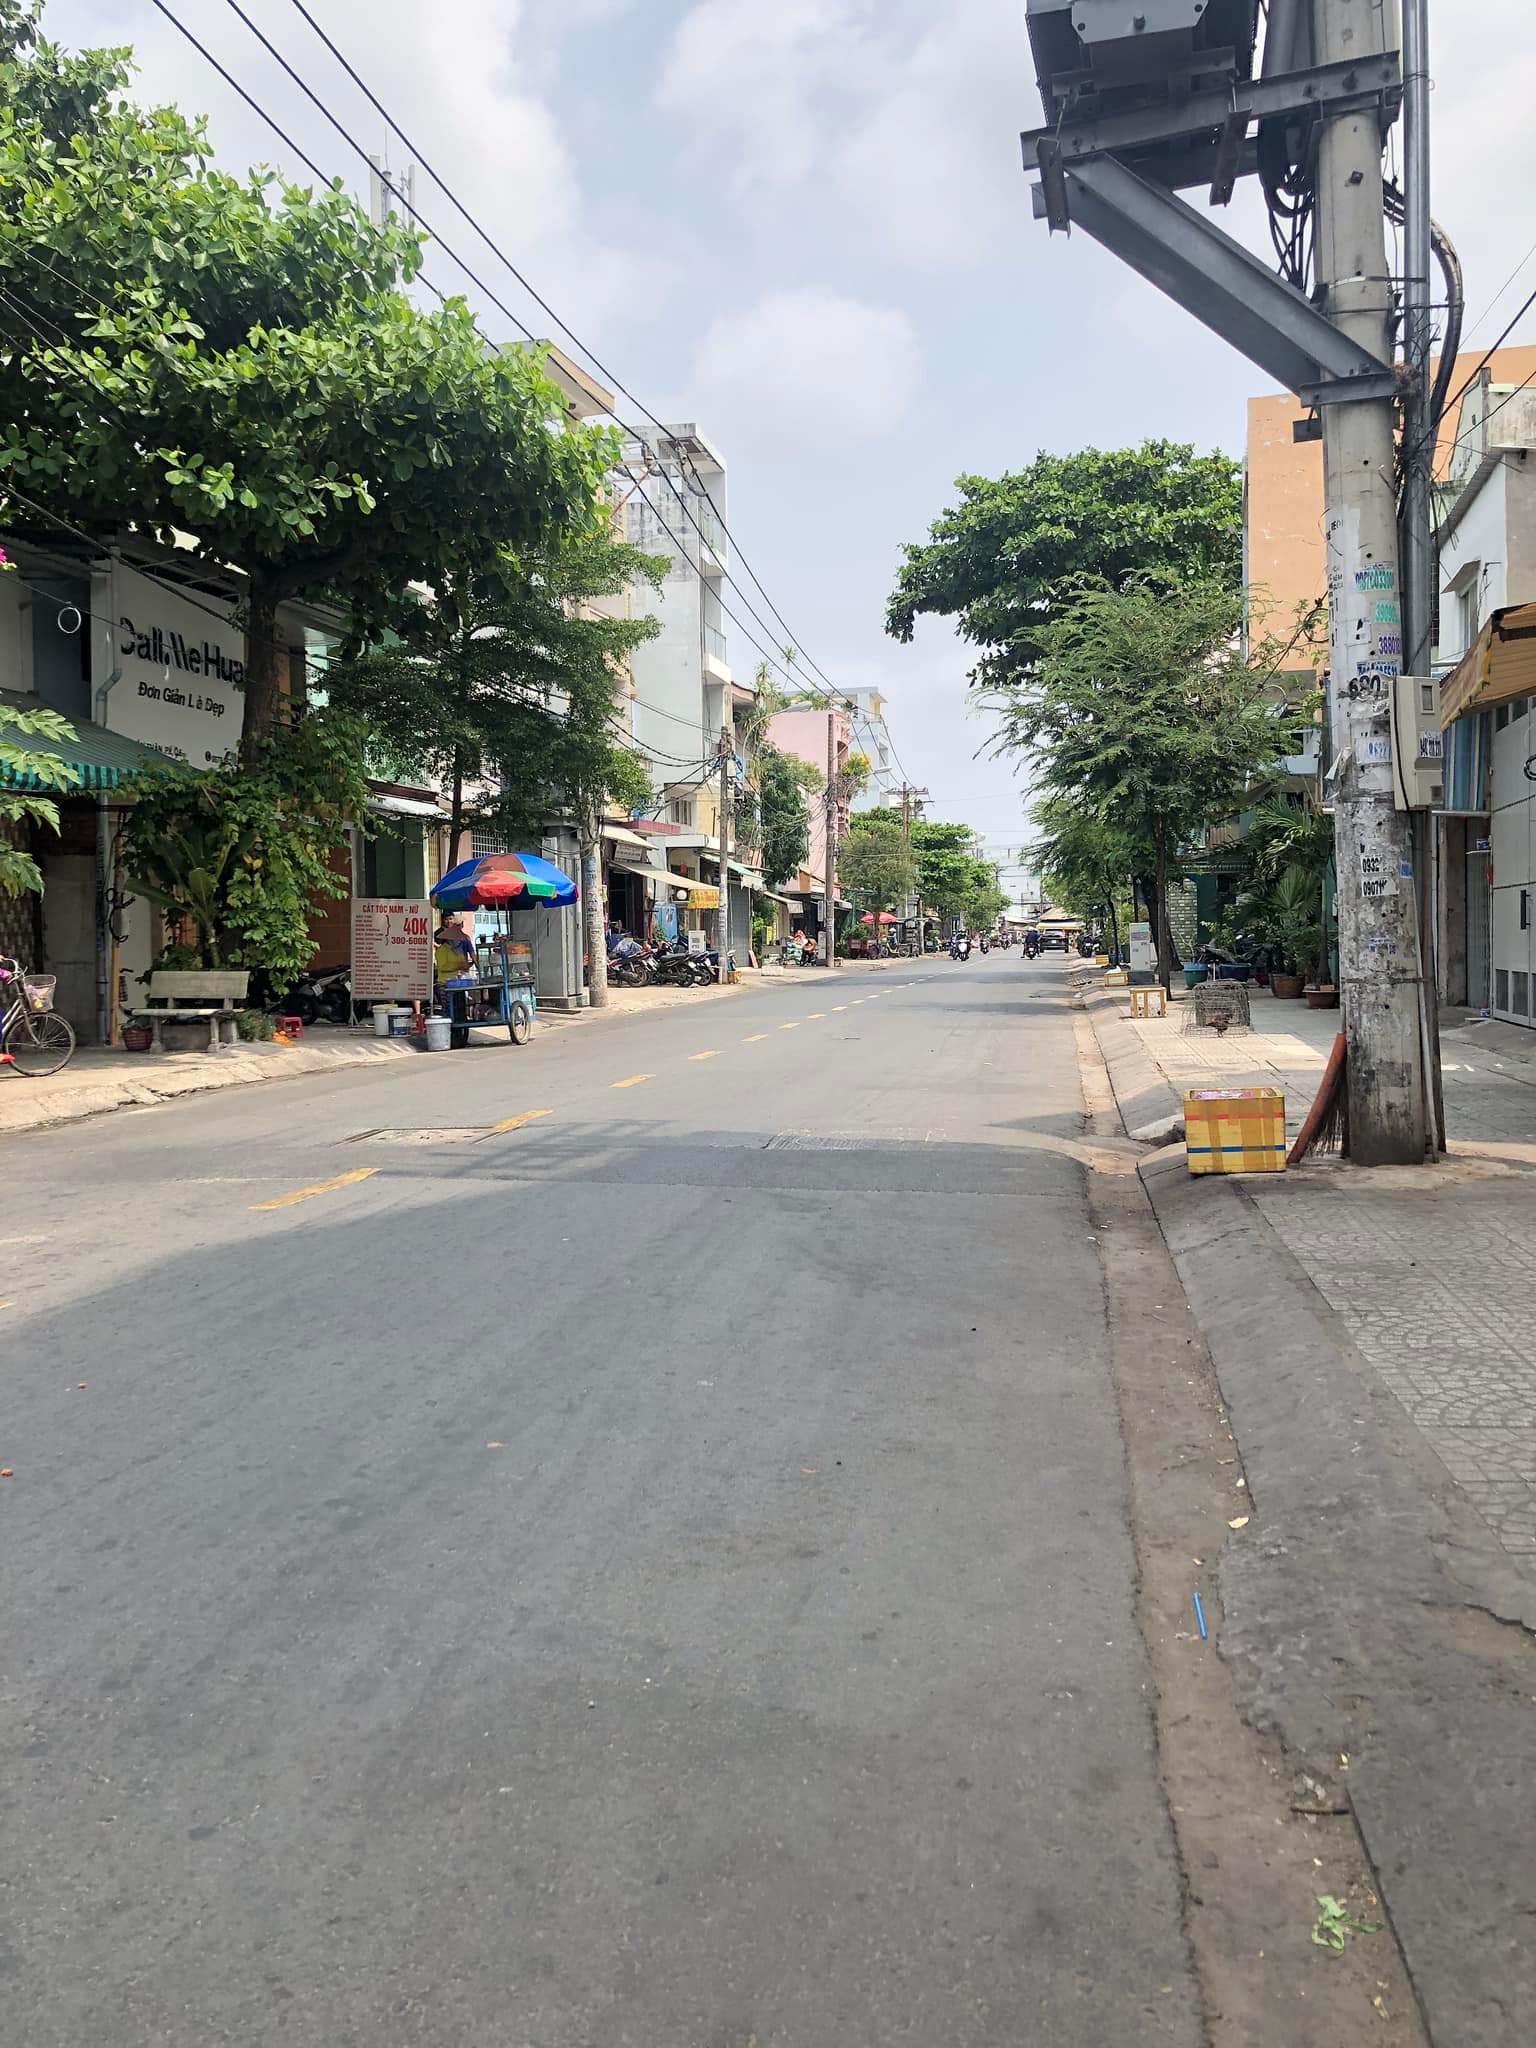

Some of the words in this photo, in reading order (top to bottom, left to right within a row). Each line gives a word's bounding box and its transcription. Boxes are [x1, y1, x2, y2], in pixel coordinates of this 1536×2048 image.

[138, 681, 160, 700] Đơn
[204, 697, 225, 718] Đẹp
[376, 903, 388, 914] TÓC
[389, 904, 404, 914] NAM
[403, 917, 428, 936] 40K
[391, 936, 428, 945] 300-600K
